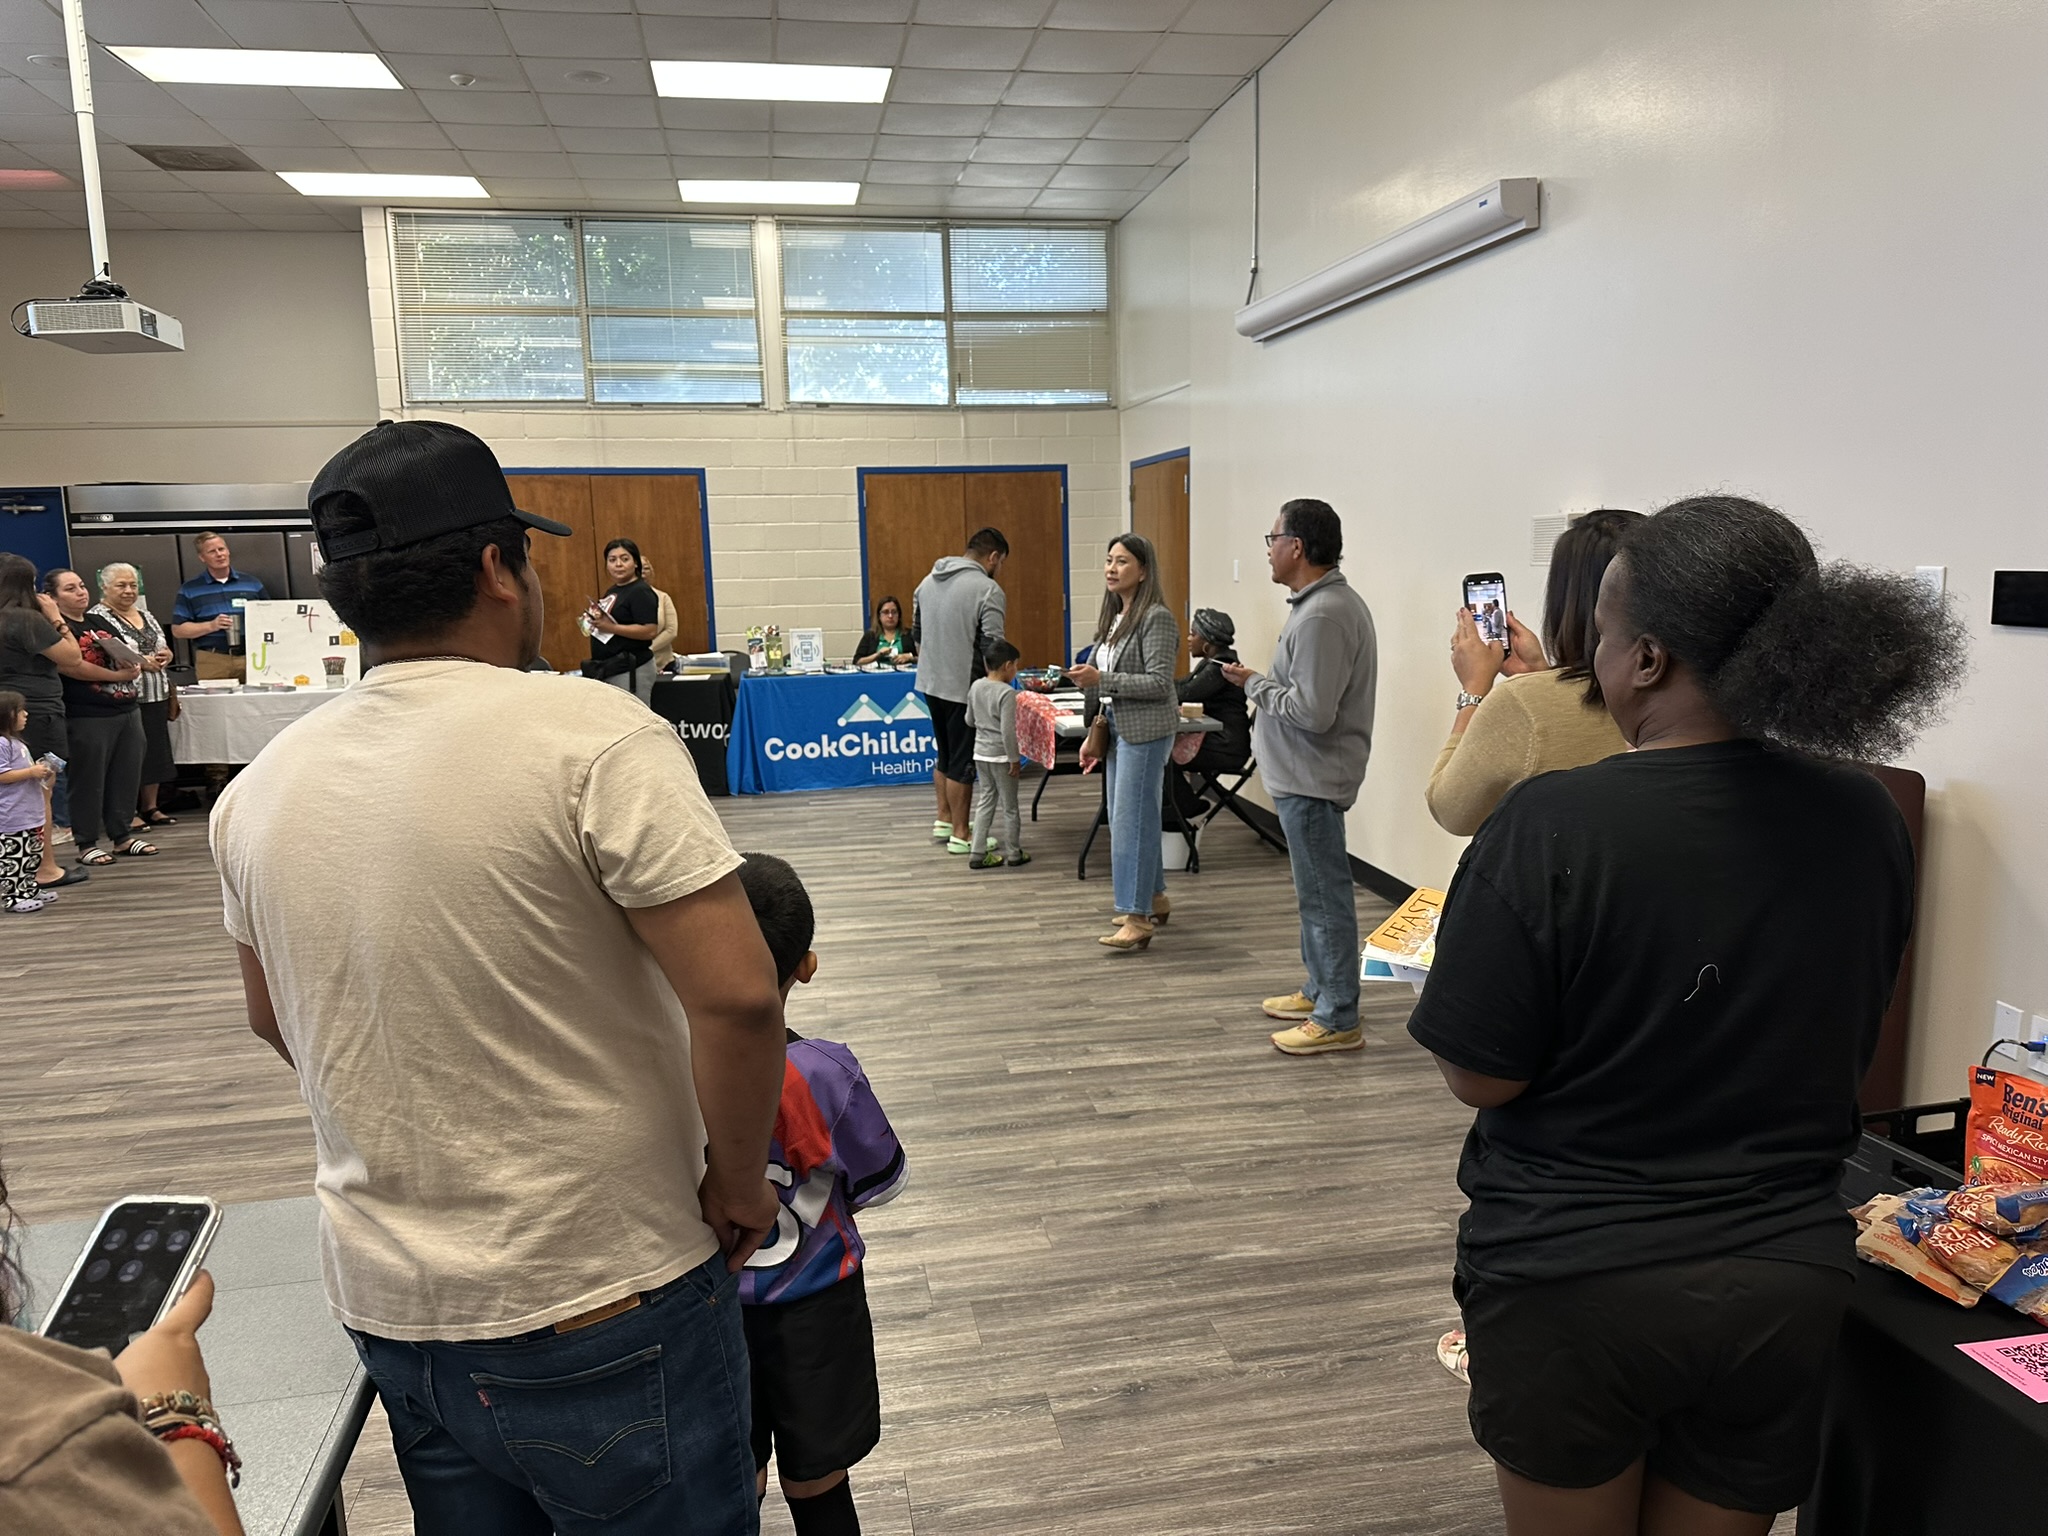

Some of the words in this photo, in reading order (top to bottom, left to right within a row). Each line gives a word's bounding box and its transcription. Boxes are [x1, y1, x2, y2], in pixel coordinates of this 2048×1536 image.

[872, 760, 922, 775] Health
[1382, 893, 1440, 940] FEAST
[1976, 1073, 1995, 1082] NEW
[2002, 1082, 2048, 1117] Ben's
[2001, 1103, 2044, 1131] Original
[1988, 1115, 2023, 1144] Ready
[2021, 1130, 2048, 1152] Ric
[1997, 1143, 2031, 1161] MEXICAN
[1933, 1230, 1997, 1258] Honey
